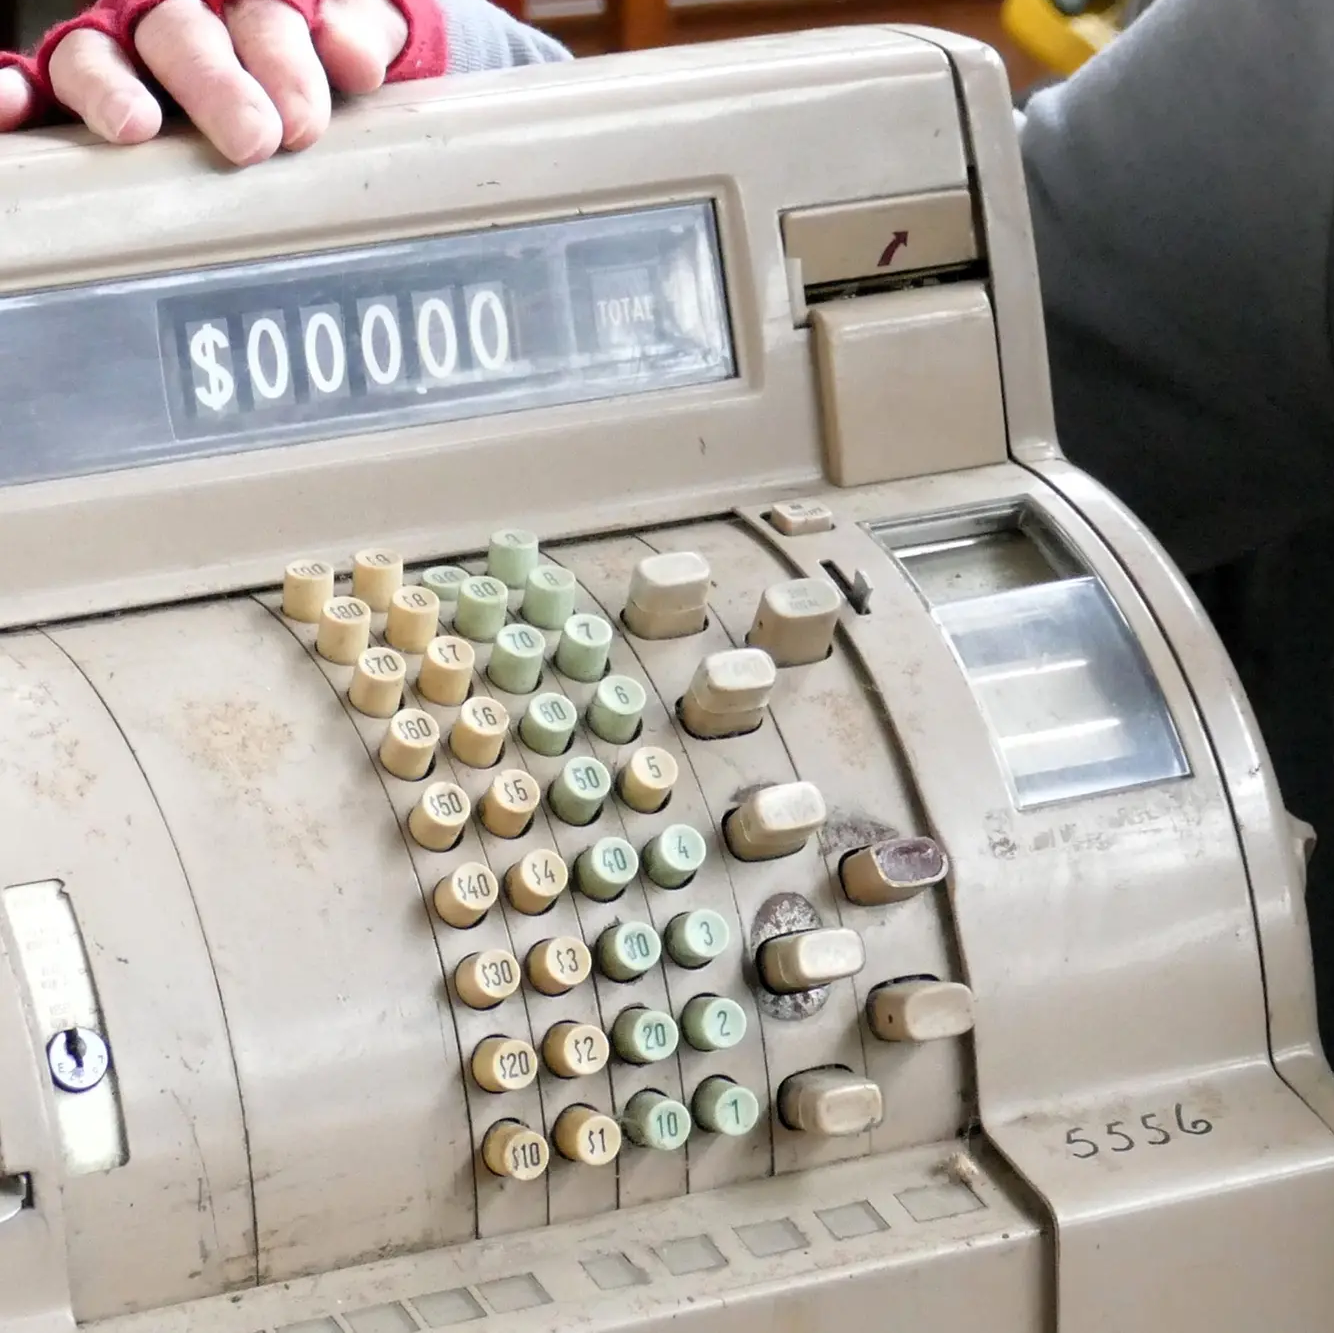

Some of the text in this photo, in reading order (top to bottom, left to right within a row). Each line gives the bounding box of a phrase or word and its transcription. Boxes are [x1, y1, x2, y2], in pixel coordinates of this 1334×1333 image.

[596, 294, 656, 328] TOTAL
[506, 630, 535, 650] 70
[576, 621, 594, 641] 7
[613, 684, 630, 705] 6
[399, 716, 433, 741] $60
[472, 705, 498, 728] $6
[571, 766, 600, 791] 50
[645, 755, 662, 779] 5
[428, 791, 463, 817] $50
[503, 778, 529, 804] $5
[601, 846, 628, 874] 40
[676, 834, 691, 860] 4
[456, 872, 490, 901] $40
[531, 859, 556, 886] $4
[698, 920, 714, 947] 3
[480, 958, 514, 989] $30
[555, 946, 579, 975] $3
[641, 1021, 667, 1052] 20
[716, 1009, 732, 1038] 2
[573, 1035, 598, 1064] $2
[499, 1049, 530, 1081] $20
[656, 1110, 679, 1140] 10
[726, 1097, 741, 1126] 1
[586, 1126, 607, 1156] $1
[1065, 1102, 1213, 1159] 5556
[510, 1141, 541, 1173] $10
